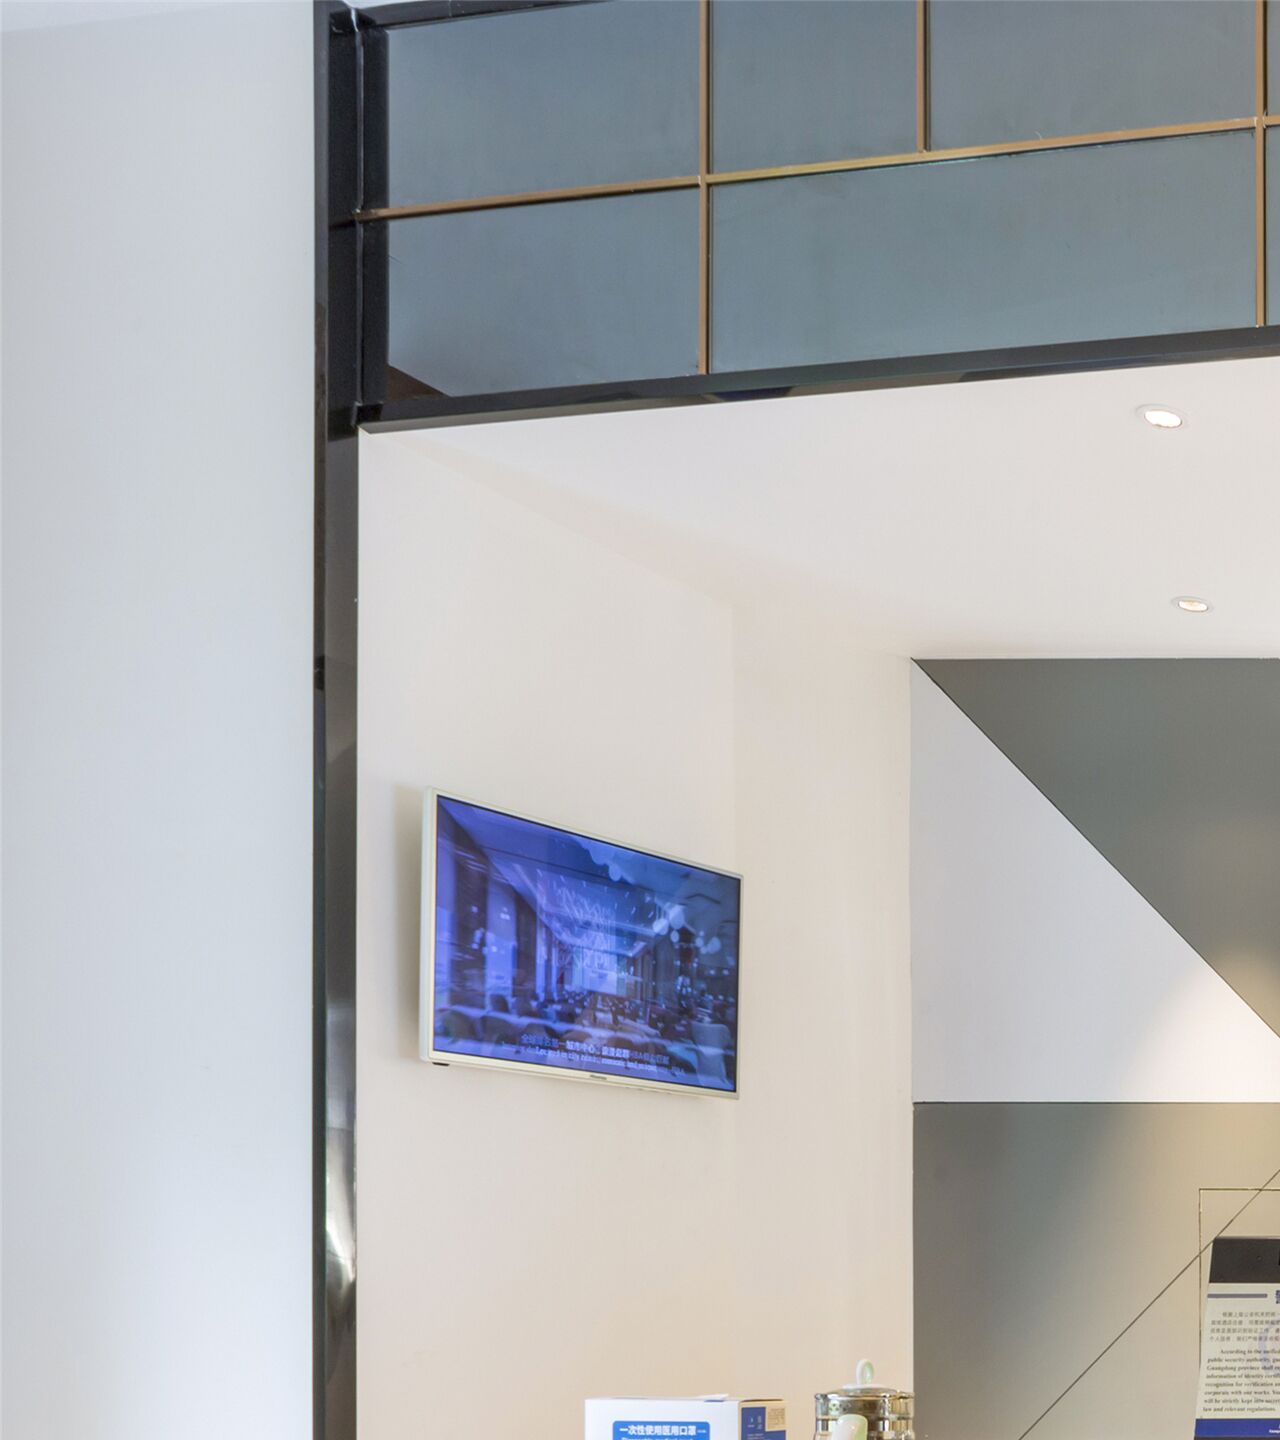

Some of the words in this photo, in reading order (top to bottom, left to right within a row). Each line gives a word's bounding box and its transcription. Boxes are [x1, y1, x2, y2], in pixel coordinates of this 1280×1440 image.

[619, 1425, 696, 1436] 一次性使用医用口罩
